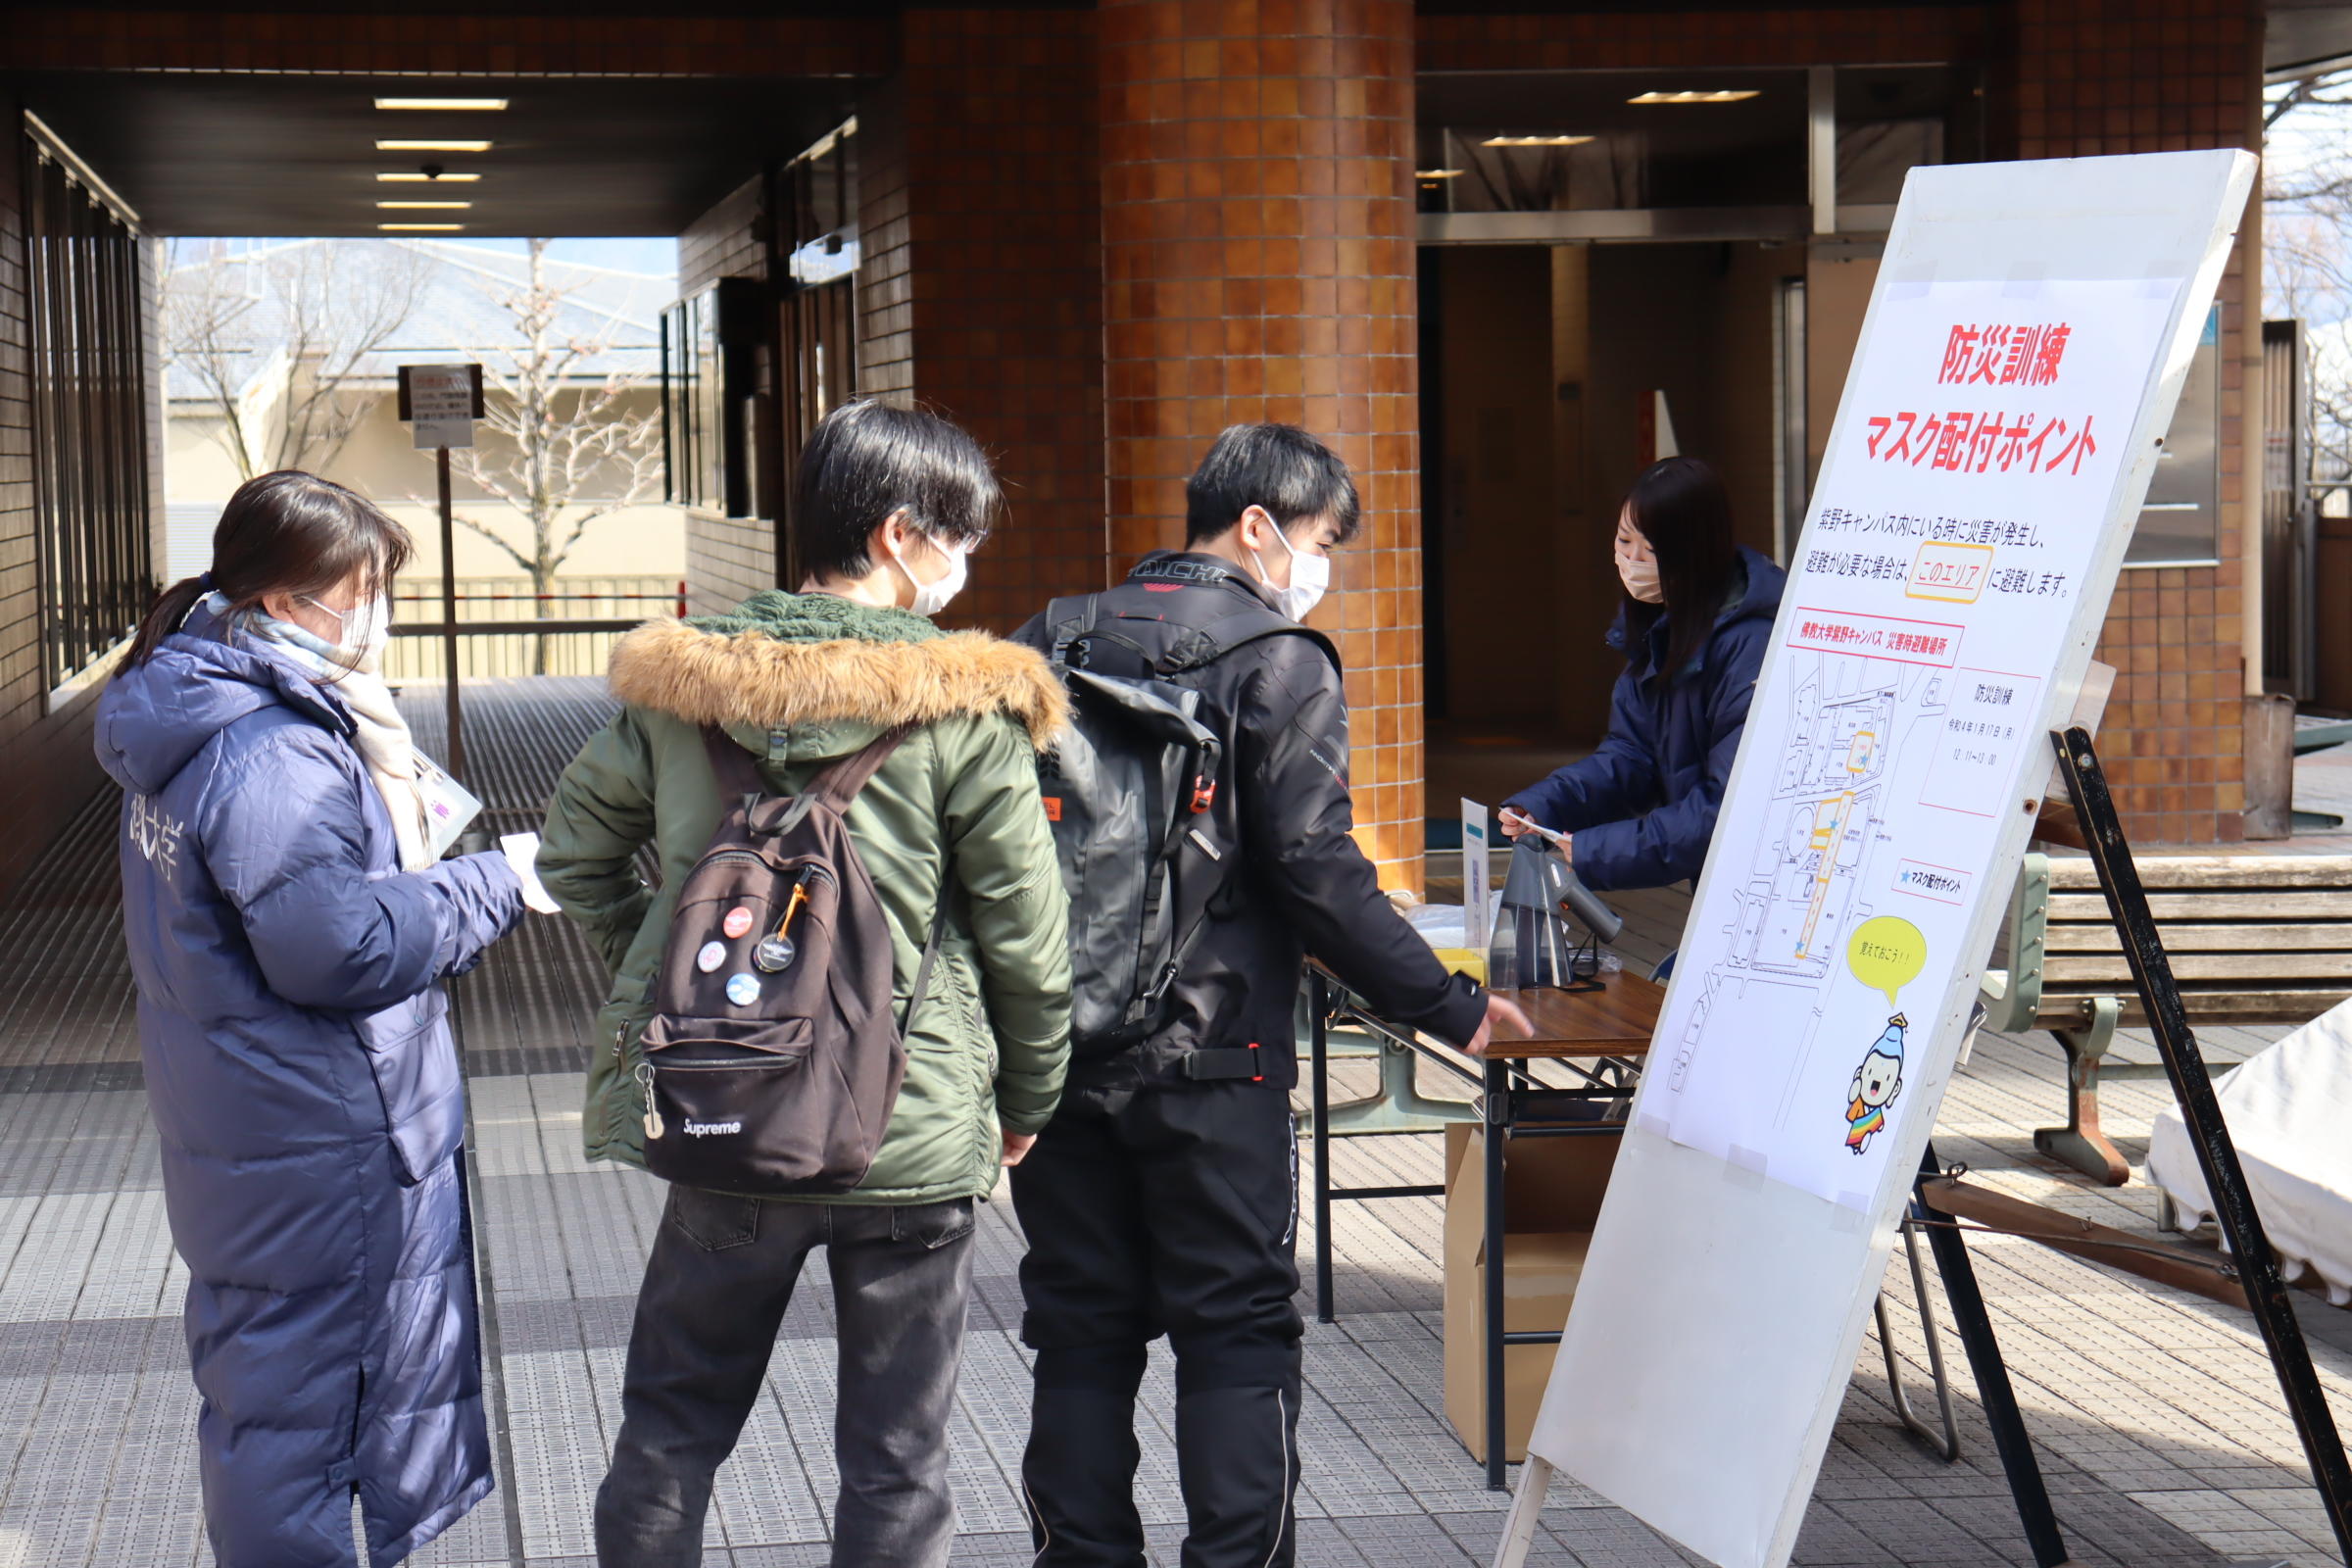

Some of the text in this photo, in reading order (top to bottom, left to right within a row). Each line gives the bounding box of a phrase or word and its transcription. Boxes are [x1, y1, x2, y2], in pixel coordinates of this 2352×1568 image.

[1937, 322, 2072, 386] 防災訓練
[1867, 411, 2096, 475] マスク配付ポイント
[1818, 508, 2044, 548] 紫野キャンパス内にいる時に災害が発生し、
[1805, 550, 2068, 599] 避難が必要な場合は、 このエリア に避難します。
[1886, 631, 1948, 657] 災害時避難場所
[1975, 683, 2014, 706] 防災訓練
[1912, 871, 1961, 894] マスク配付ポイント
[683, 1117, 742, 1139] Supreme
